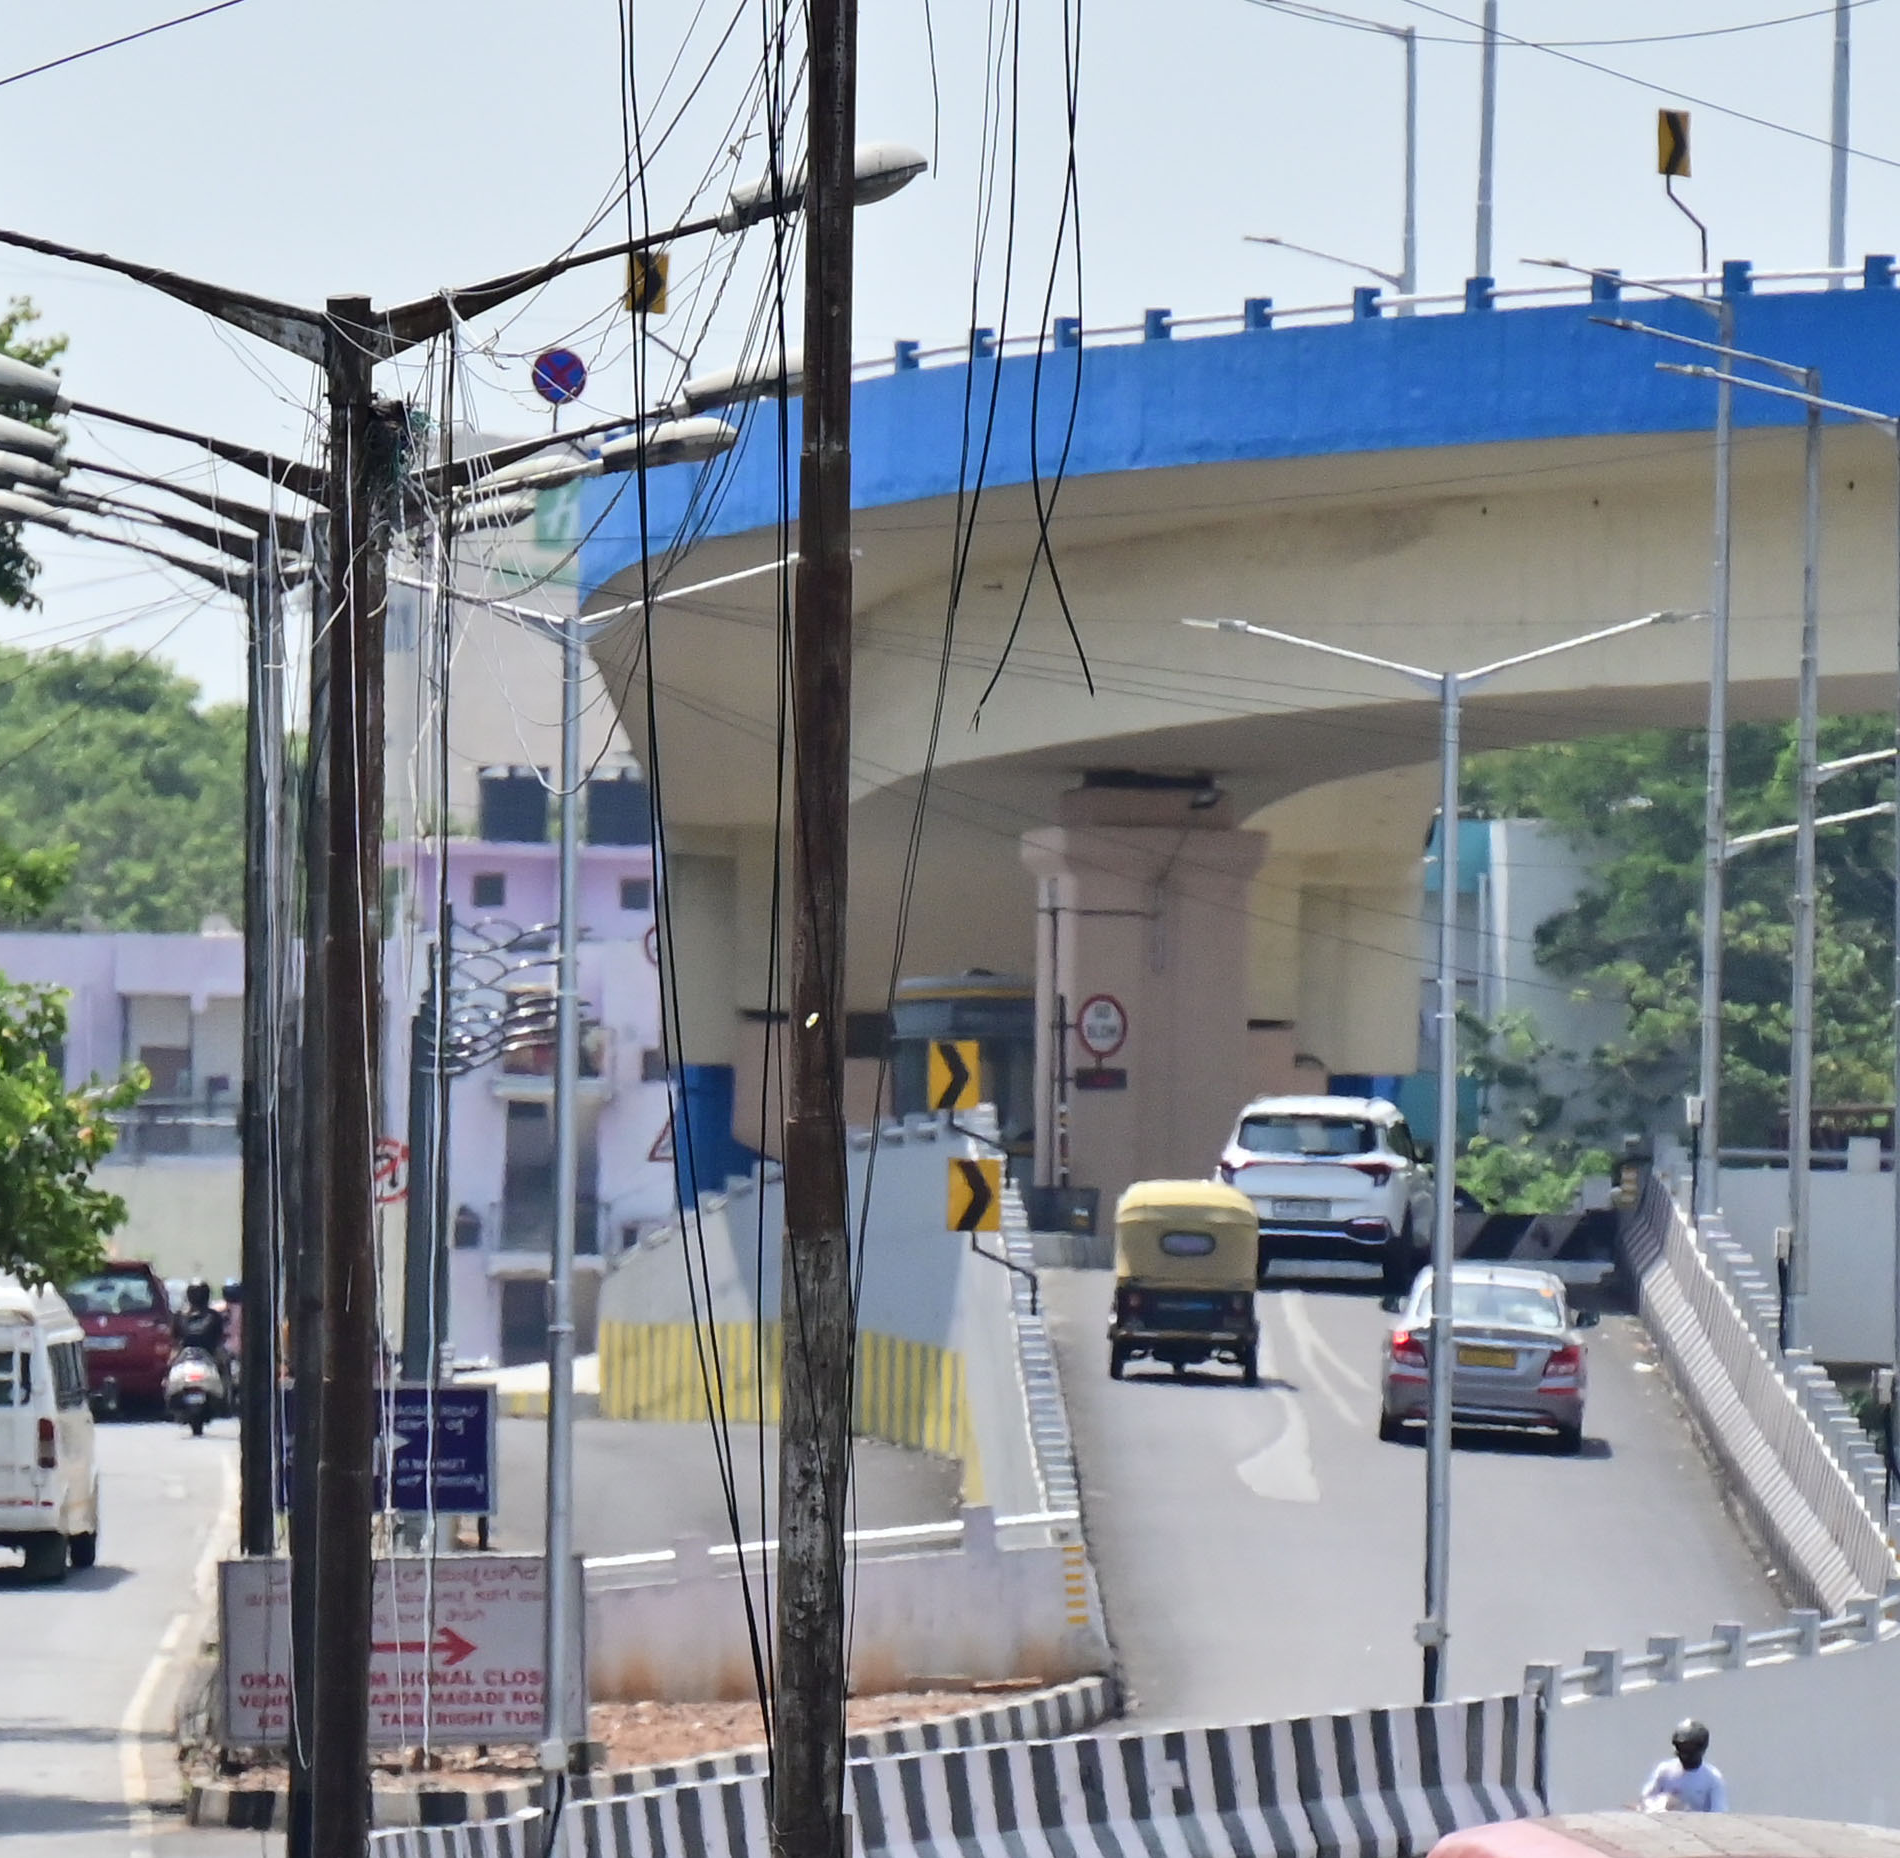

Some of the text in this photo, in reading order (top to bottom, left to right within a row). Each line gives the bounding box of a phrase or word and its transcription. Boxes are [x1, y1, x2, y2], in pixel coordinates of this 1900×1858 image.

[1086, 1024, 1117, 1039] SLOW
[435, 1712, 495, 1728] RIGHT
[502, 1712, 543, 1728] TUR
